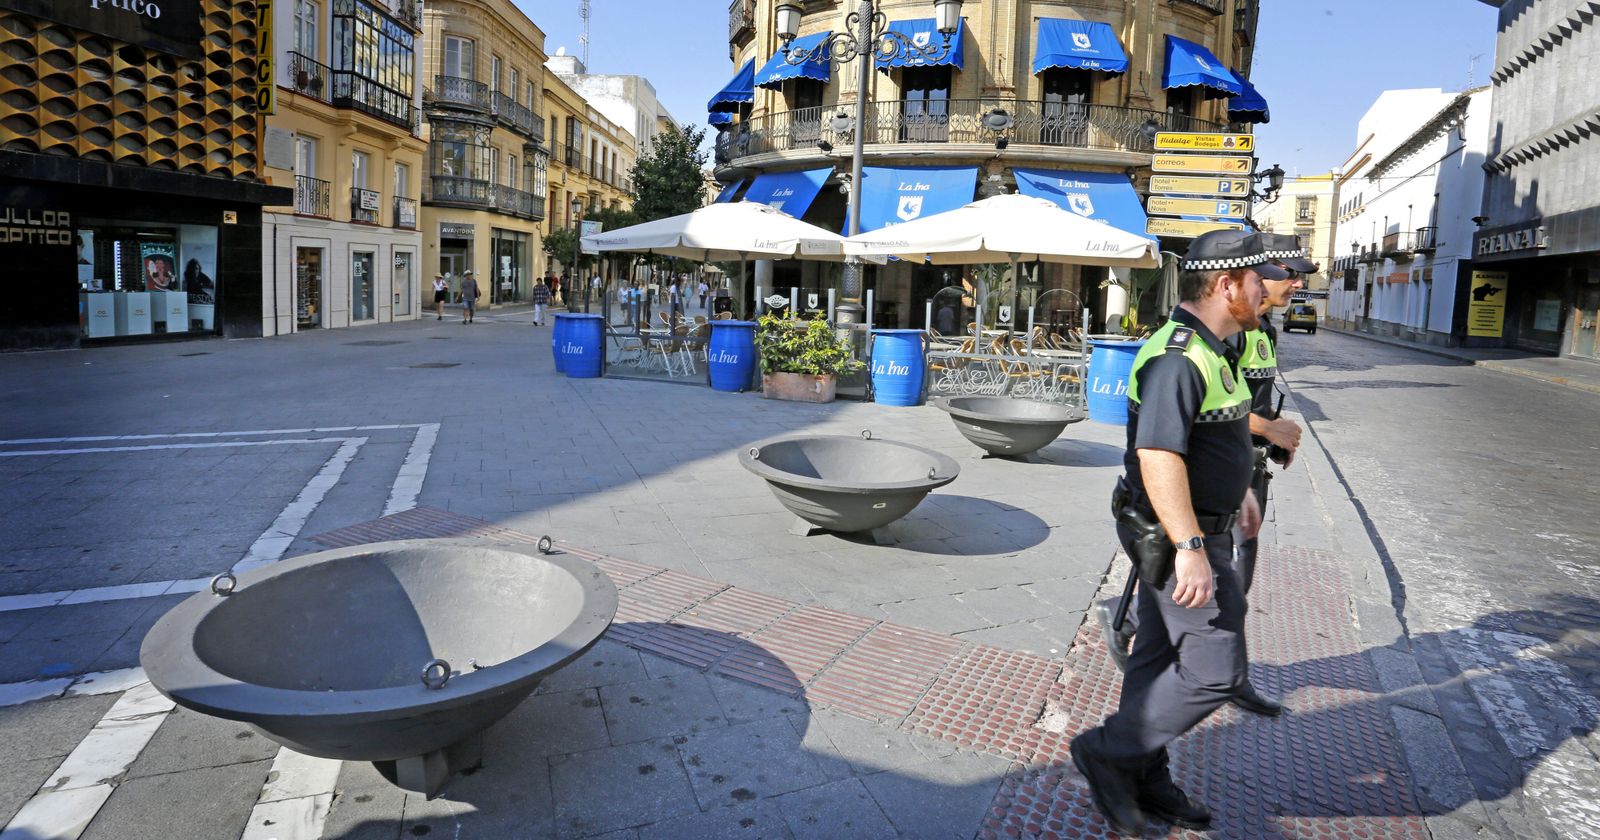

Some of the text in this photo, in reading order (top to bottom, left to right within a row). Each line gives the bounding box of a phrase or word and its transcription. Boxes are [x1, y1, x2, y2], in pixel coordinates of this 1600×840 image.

[1082, 59, 1090, 67] La
[1160, 137, 1191, 145] Hidalgo
[897, 182, 931, 191] La Ina
[1059, 179, 1090, 189] La Ina
[1221, 182, 1229, 192] P
[772, 188, 794, 197] La Ina
[1218, 203, 1228, 213] P
[754, 239, 778, 250] La Ina
[1086, 240, 1120, 253] La Ina
[567, 342, 583, 354] Ina
[708, 348, 717, 363] La
[718, 349, 738, 365] Ina
[872, 359, 909, 377] La Ina
[1092, 376, 1130, 396] La In
